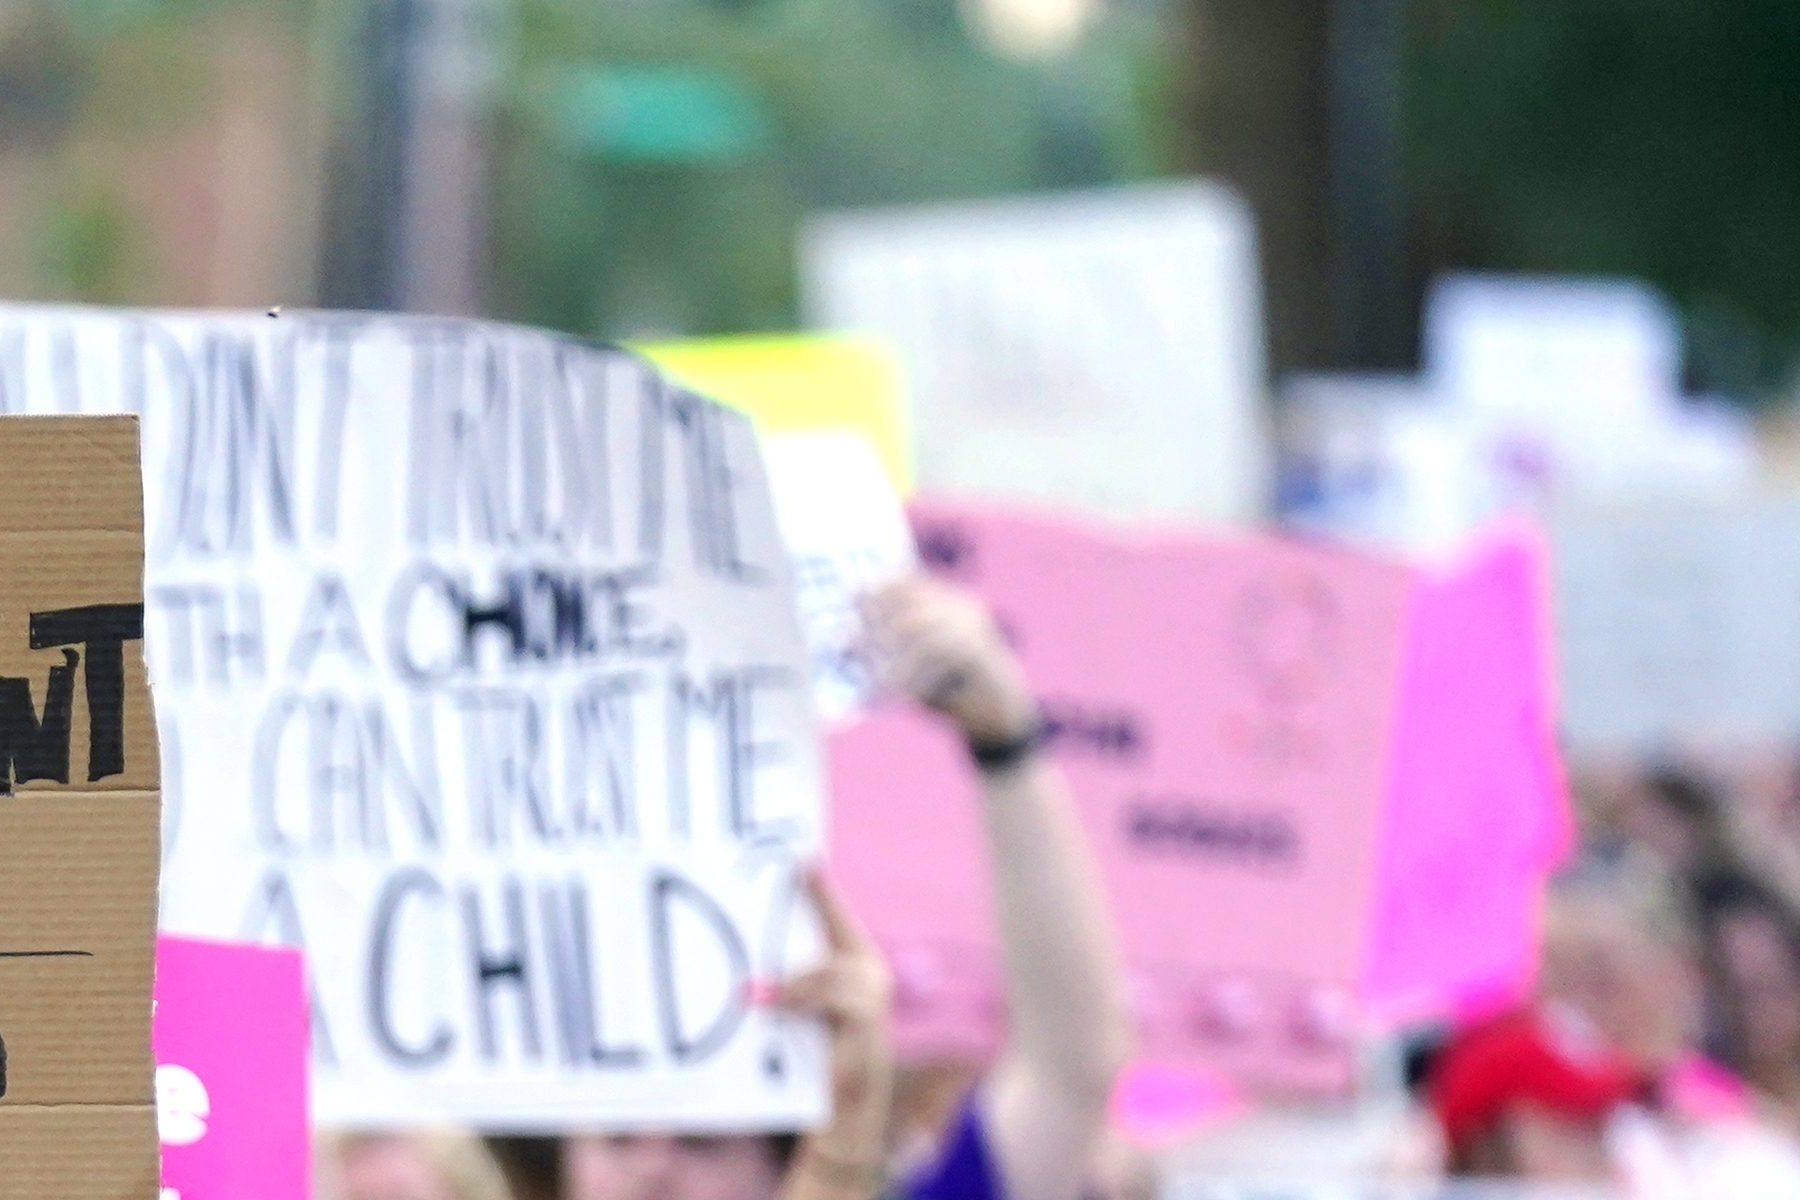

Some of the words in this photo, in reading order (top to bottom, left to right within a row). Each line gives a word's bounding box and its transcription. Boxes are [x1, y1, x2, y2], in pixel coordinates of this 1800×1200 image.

[287, 568, 372, 678] A
[250, 685, 443, 855] CAN
[664, 662, 806, 846] ME
